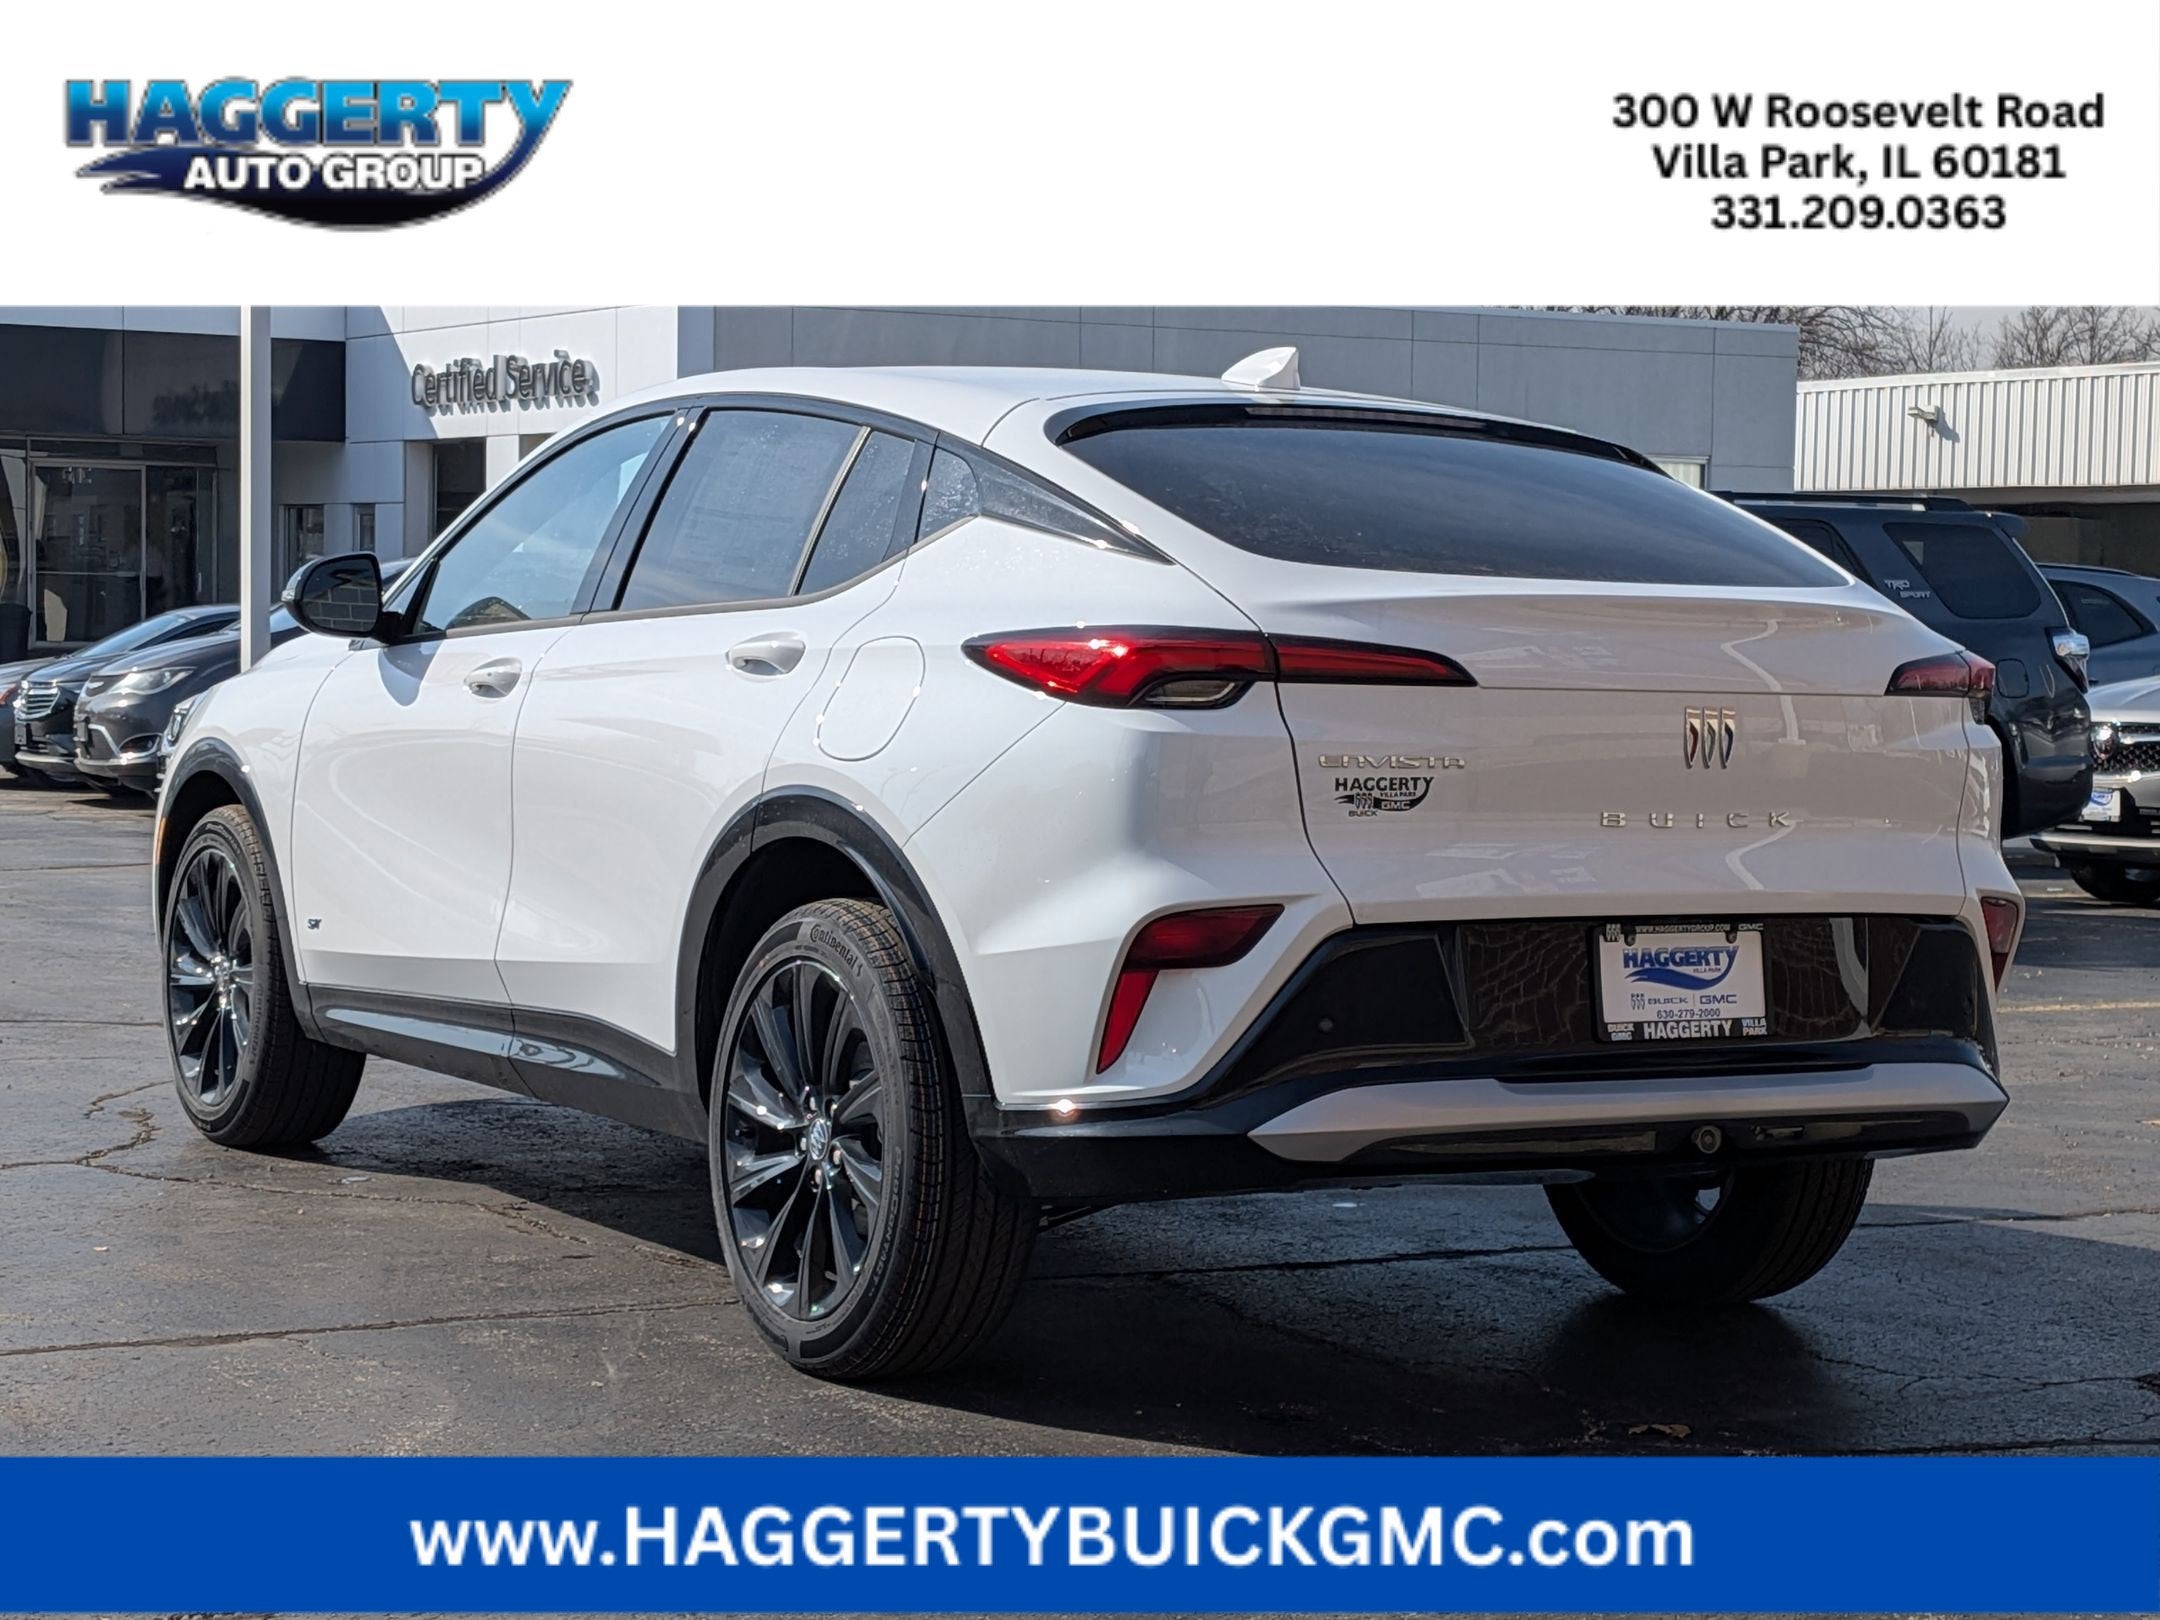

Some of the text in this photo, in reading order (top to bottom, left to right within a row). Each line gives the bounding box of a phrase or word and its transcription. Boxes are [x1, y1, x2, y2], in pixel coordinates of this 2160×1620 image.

[411, 350, 590, 406] Certified Service
[1335, 777, 1434, 792] HAGGERTY
[1381, 801, 1410, 809] GMC
[1602, 812, 1790, 828] BUICK
[1738, 923, 1763, 931] GMC
[1623, 946, 1739, 969] HAGGERTY
[1648, 994, 1737, 1005] BUICK GMC
[1656, 1008, 1721, 1019] 630-279-2000
[1608, 1018, 1767, 1039] BUICK HAGGERTY VILLA
[1743, 1027, 1767, 1035] PARK
